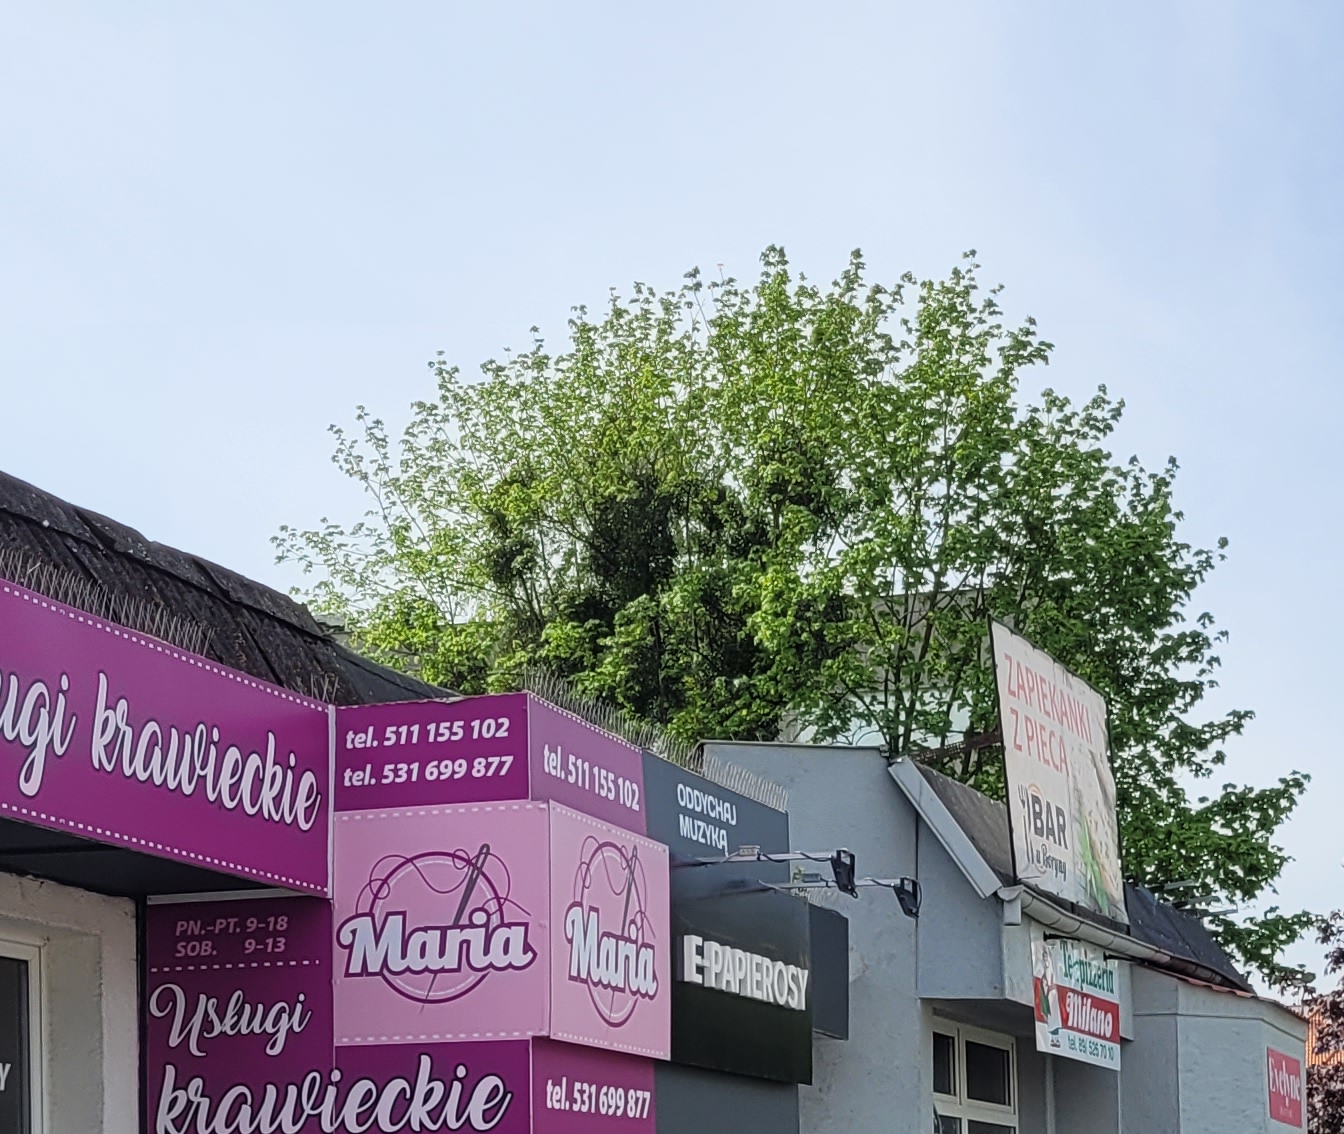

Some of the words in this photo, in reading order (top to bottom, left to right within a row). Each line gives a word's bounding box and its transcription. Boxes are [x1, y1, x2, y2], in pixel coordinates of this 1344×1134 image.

[1004, 652, 1093, 745] ZAPIEKANKI
[92, 672, 321, 831] krawieckie
[346, 726, 378, 749] tel.
[383, 724, 419, 746] 511
[427, 721, 464, 743] 155
[470, 717, 510, 739] 102
[1009, 707, 1023, 753] Z
[1024, 714, 1070, 777] PIECA
[343, 764, 376, 787] tel.
[381, 762, 419, 784] 531
[425, 759, 467, 781] 699
[471, 755, 514, 778] 877
[543, 743, 565, 780] tel.
[568, 754, 590, 790] 511
[593, 766, 616, 800] 155
[618, 777, 640, 811] 102
[677, 783, 737, 826] ODDYCHAJ
[1031, 793, 1068, 850] BAR
[679, 814, 729, 857] MUZYKĄ
[175, 918, 241, 936] PN.-PT.
[246, 915, 288, 932] 9-18
[175, 941, 217, 957] SOB.
[244, 937, 286, 954] 9-13
[338, 908, 536, 976] Maria
[565, 902, 657, 999] Maria
[684, 934, 808, 1011] E-PAPIEROSY
[1060, 940, 1114, 995] Tepizzeria
[149, 983, 312, 1057] Usługi
[1066, 992, 1113, 1038] Milano
[546, 1076, 570, 1110] tel.
[573, 1081, 596, 1114] 531
[599, 1085, 625, 1117] 699
[627, 1089, 650, 1119] 877
